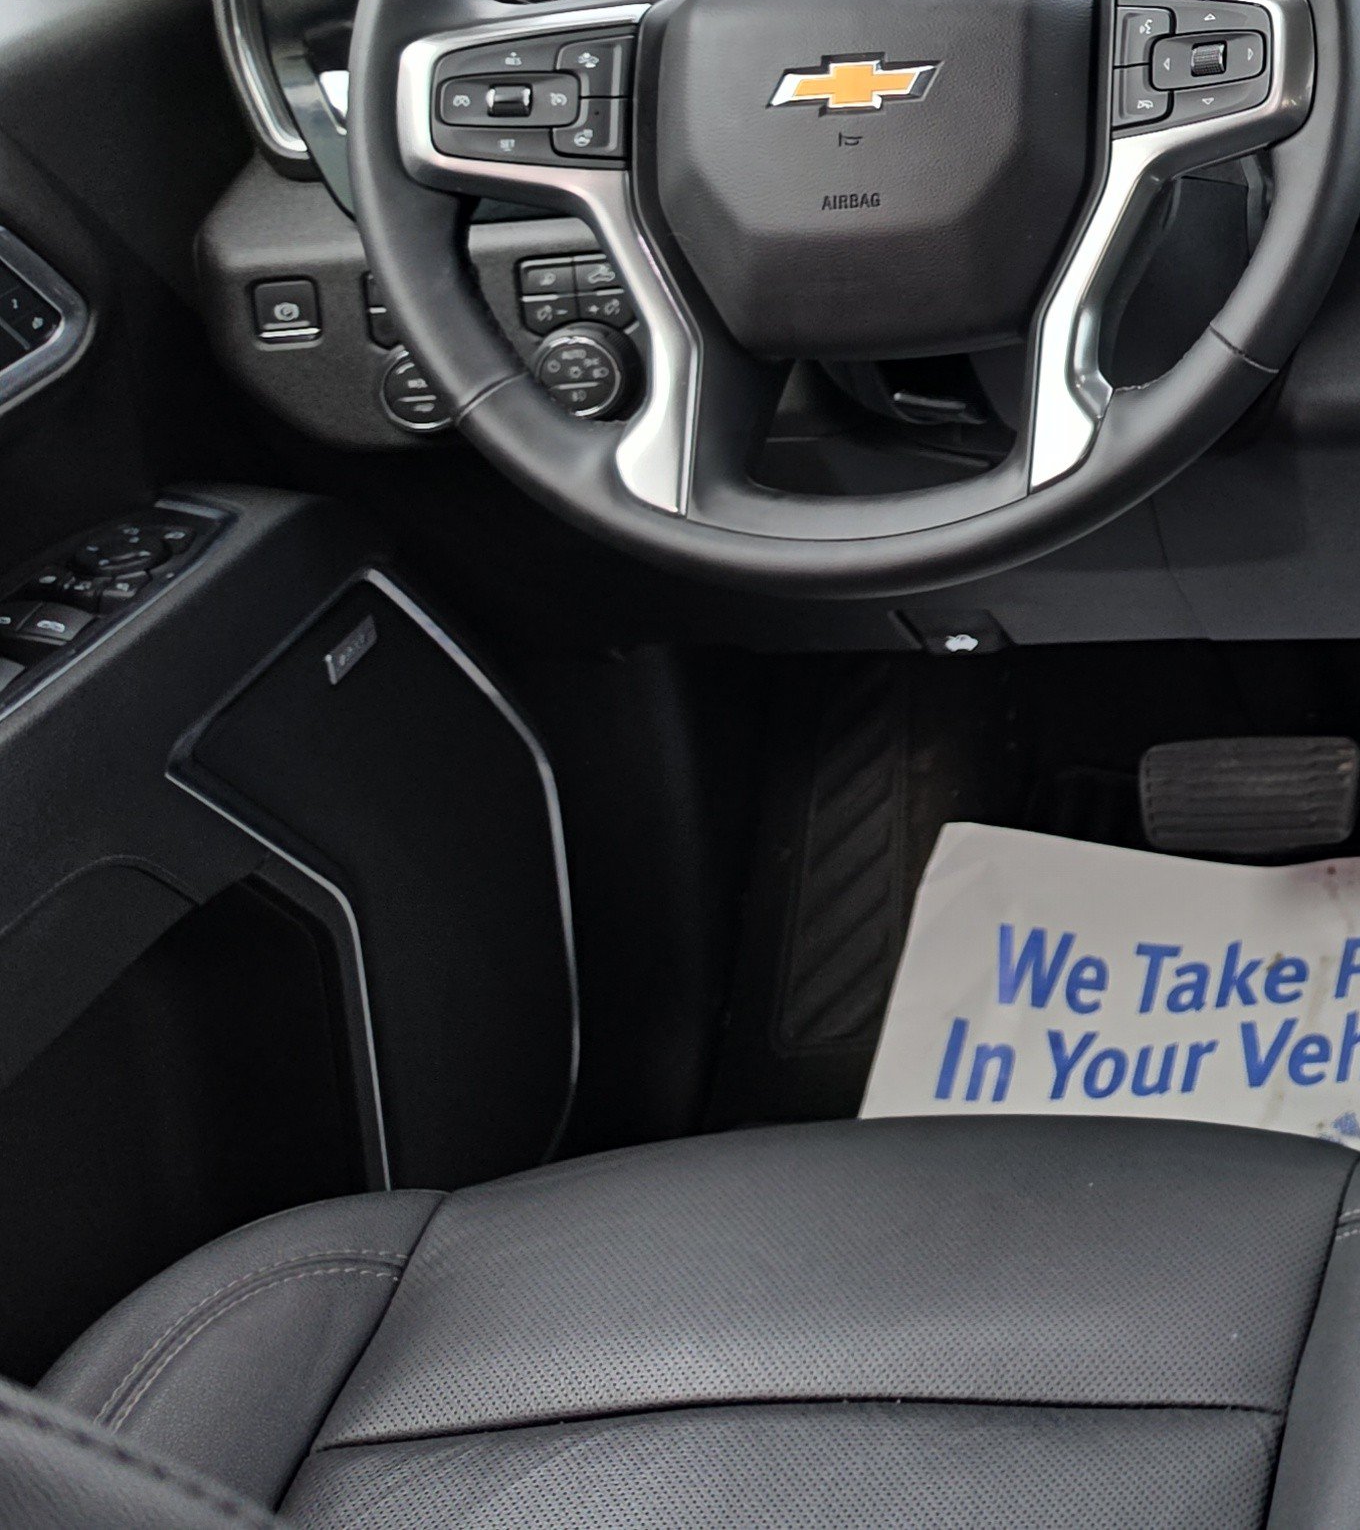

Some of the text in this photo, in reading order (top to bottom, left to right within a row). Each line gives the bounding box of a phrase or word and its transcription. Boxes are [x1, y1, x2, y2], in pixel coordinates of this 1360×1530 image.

[821, 192, 882, 211] AIRBAG
[997, 922, 1110, 1016] We
[1132, 939, 1308, 1015] Take
[932, 1017, 1015, 1103] In
[1046, 1028, 1220, 1100] Your
